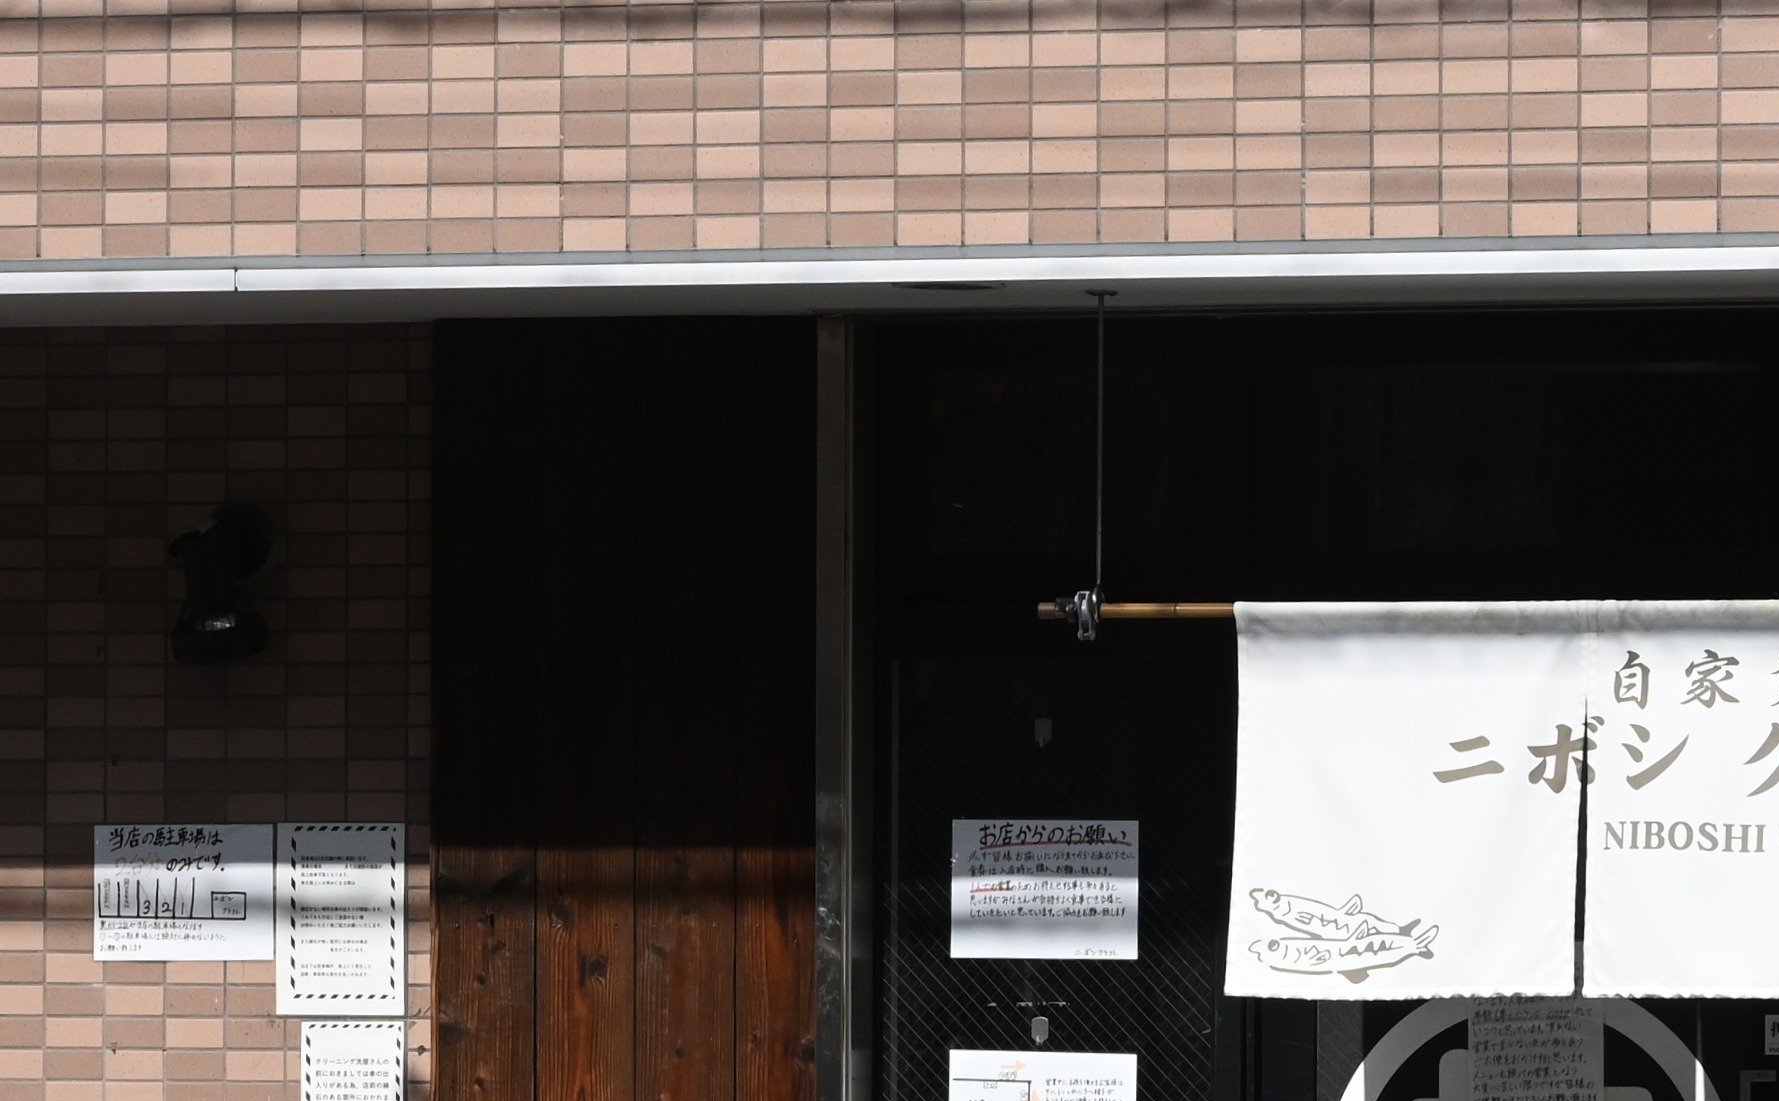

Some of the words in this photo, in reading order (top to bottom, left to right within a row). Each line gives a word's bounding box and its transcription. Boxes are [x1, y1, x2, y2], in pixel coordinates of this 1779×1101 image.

[1432, 714, 1690, 795] ニボシ
[108, 826, 223, 854] 当店の駐車場は
[979, 822, 1127, 846] お店からのお願い
[1603, 821, 1767, 853] NIBOSHI
[142, 900, 152, 916] 3
[161, 901, 172, 913] 2
